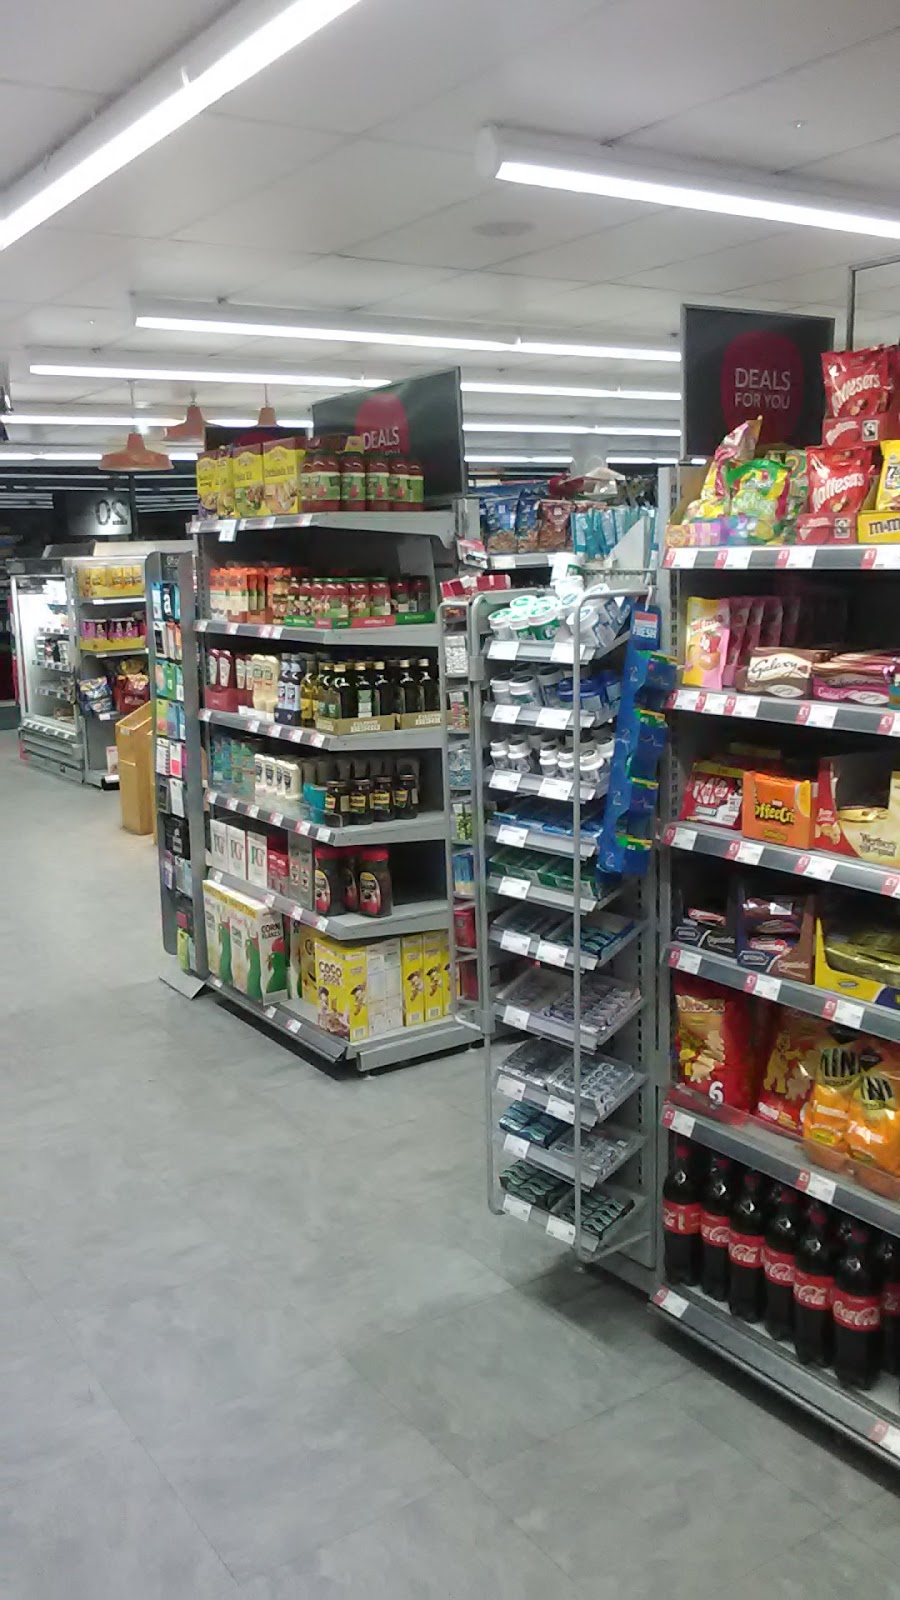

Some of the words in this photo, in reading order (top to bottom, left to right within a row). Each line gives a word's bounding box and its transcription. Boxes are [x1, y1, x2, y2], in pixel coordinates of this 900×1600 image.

[735, 368, 791, 391] DEALS
[735, 392, 761, 408] FOR
[764, 394, 791, 409] YOU
[363, 426, 400, 450] DEALS
[319, 961, 342, 977] COCO
[709, 1081, 724, 1105] 6
